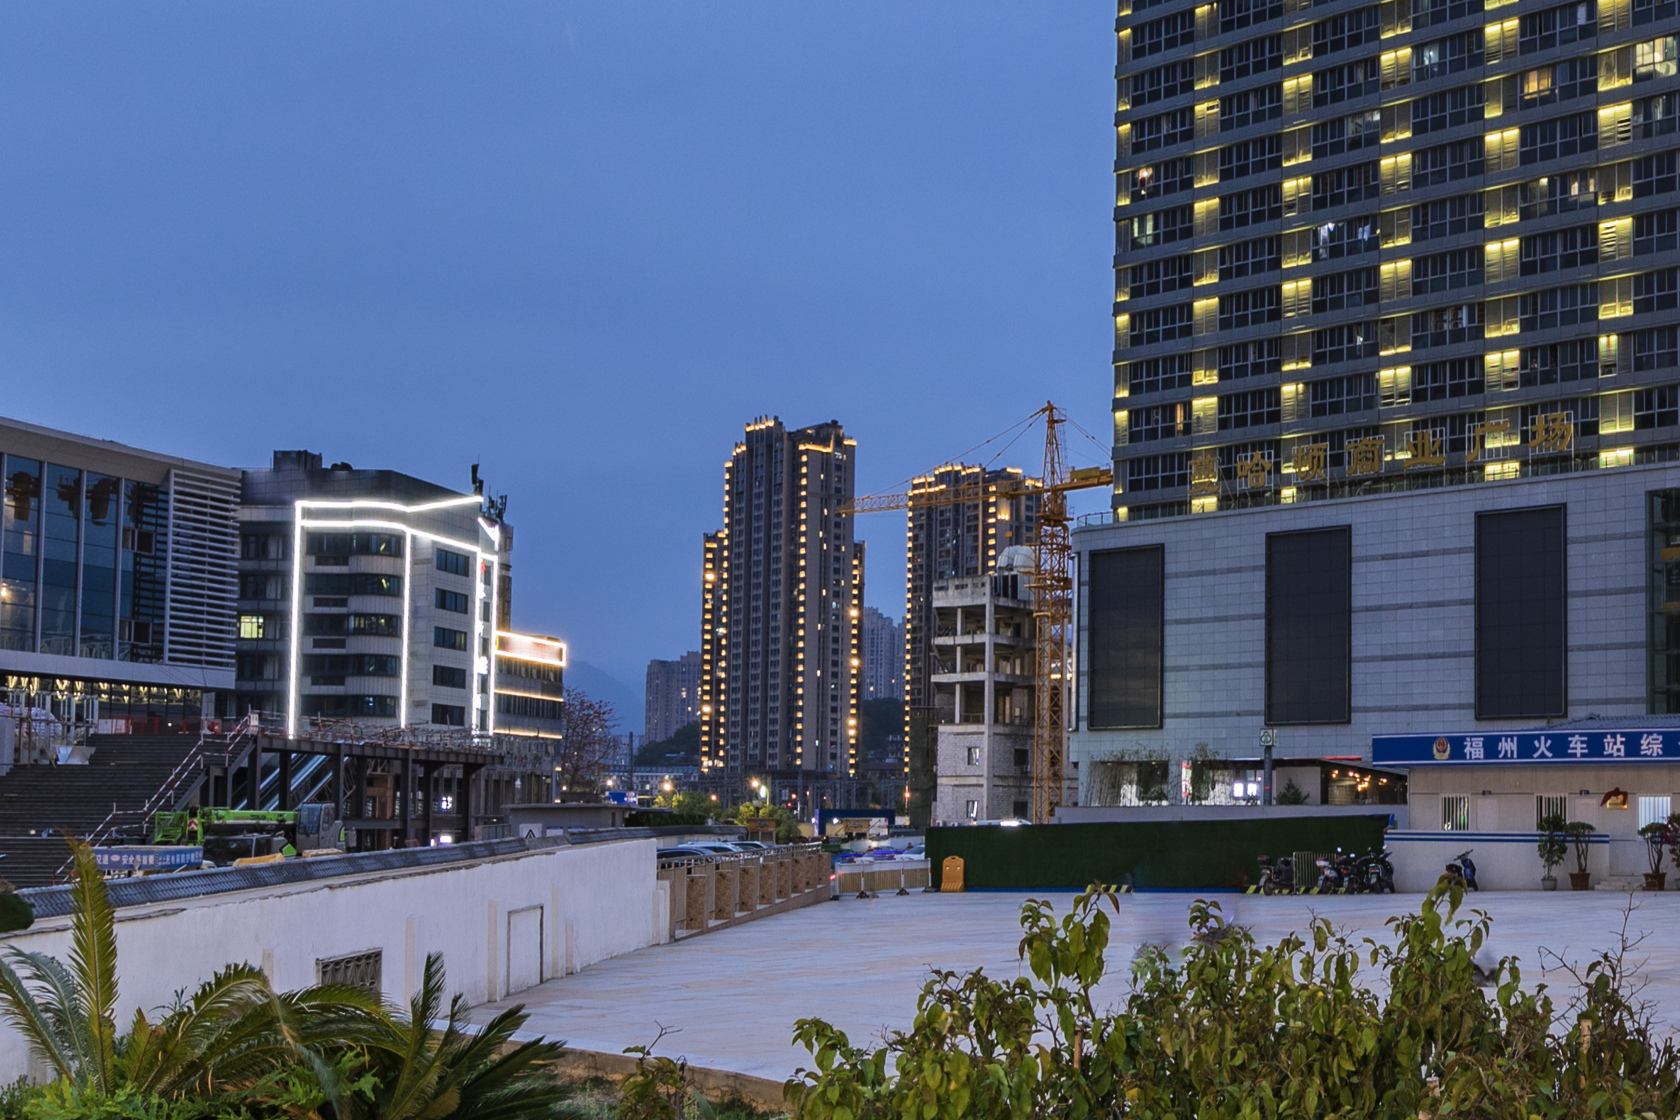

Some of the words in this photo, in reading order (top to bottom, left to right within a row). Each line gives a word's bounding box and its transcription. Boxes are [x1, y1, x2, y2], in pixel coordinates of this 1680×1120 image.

[1187, 411, 1574, 495] 曼哈顿商业广场
